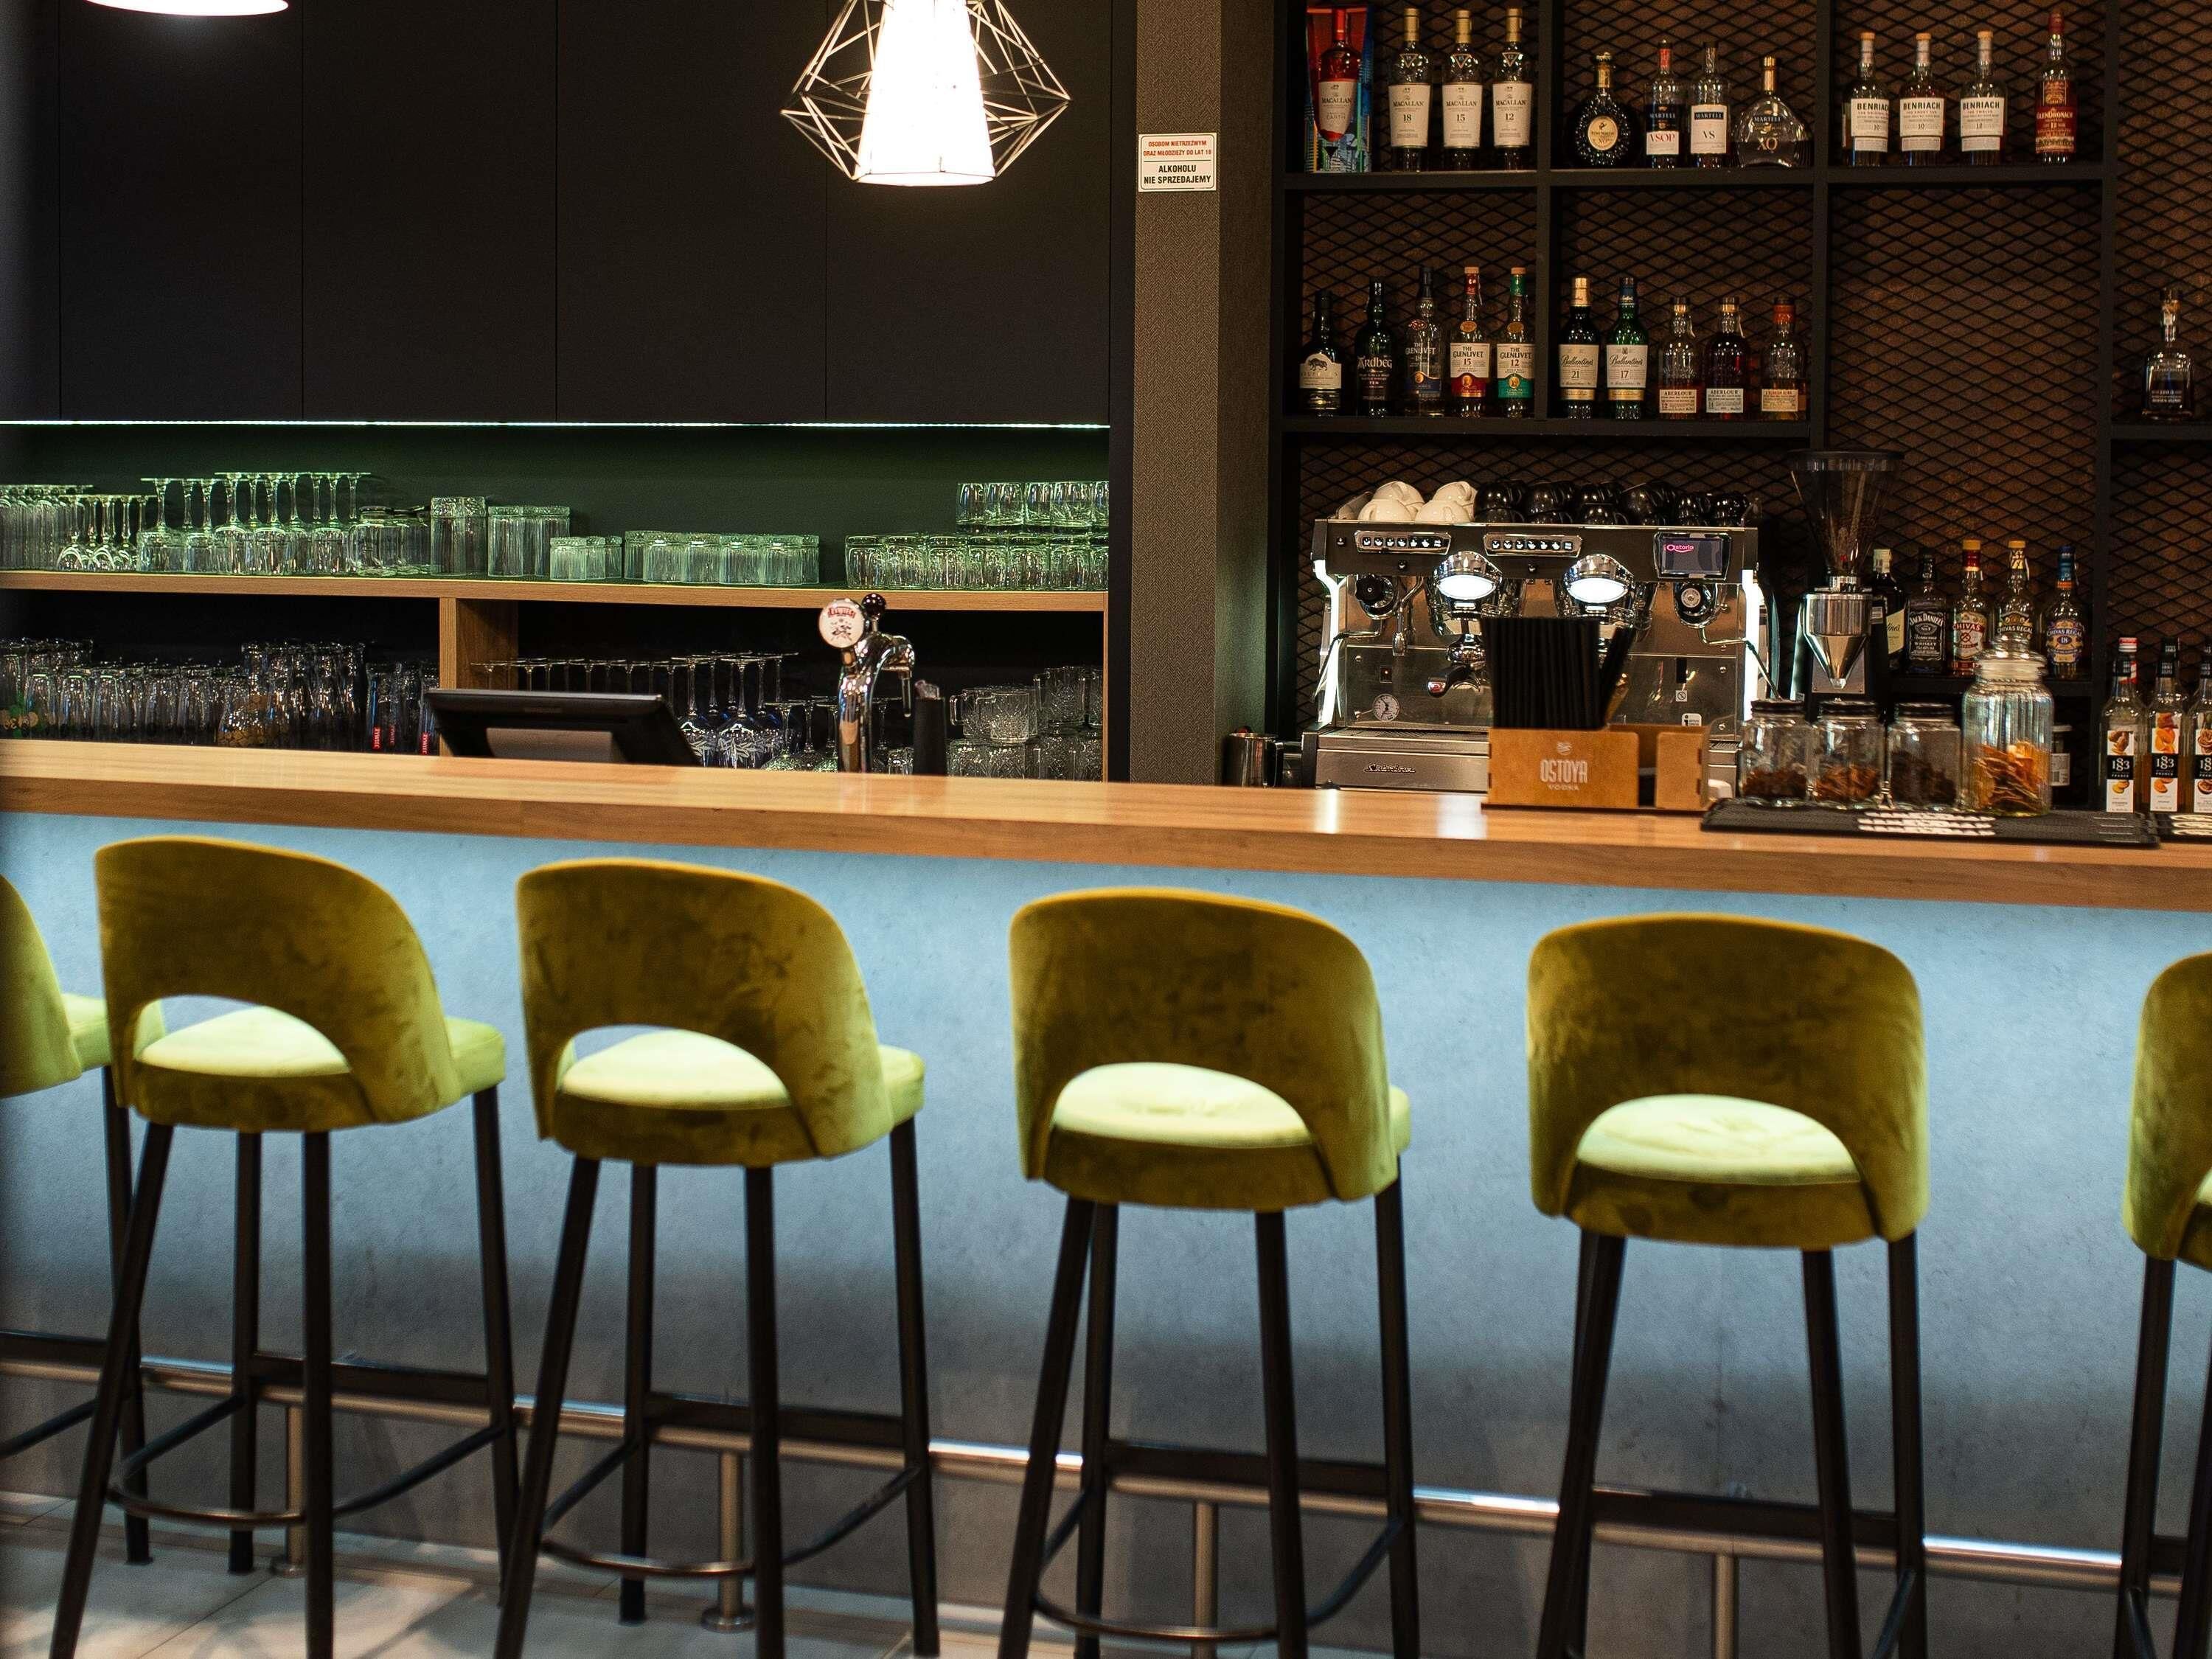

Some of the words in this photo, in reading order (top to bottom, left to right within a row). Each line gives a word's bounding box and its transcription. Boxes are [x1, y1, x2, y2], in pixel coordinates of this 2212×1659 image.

[1903, 102, 1941, 111] BENRIACH
[1963, 101, 2000, 110] BENRIACH
[1650, 133, 1675, 142] VSOP
[1703, 131, 1715, 139] VS
[1758, 137, 1778, 150] XO
[1158, 164, 1197, 173] ALKOHOLU
[1144, 176, 1156, 184] NIE
[1158, 175, 1211, 184] SPRZEDAJEMY
[1571, 370, 1579, 378] 21
[1621, 370, 1629, 378] 17
[1909, 615, 1923, 625] JACK
[1952, 623, 1980, 631] CHIVAS
[1997, 625, 2016, 633] CHIVAS
[2017, 625, 2033, 633] REGAL
[2046, 628, 2065, 637] CHIVAS
[2065, 628, 2082, 637] REGAL
[2112, 757, 2130, 771] 1883
[2157, 755, 2174, 770] 1883
[2200, 757, 2212, 771] 188
[1540, 759, 1588, 783] OSTOYA
